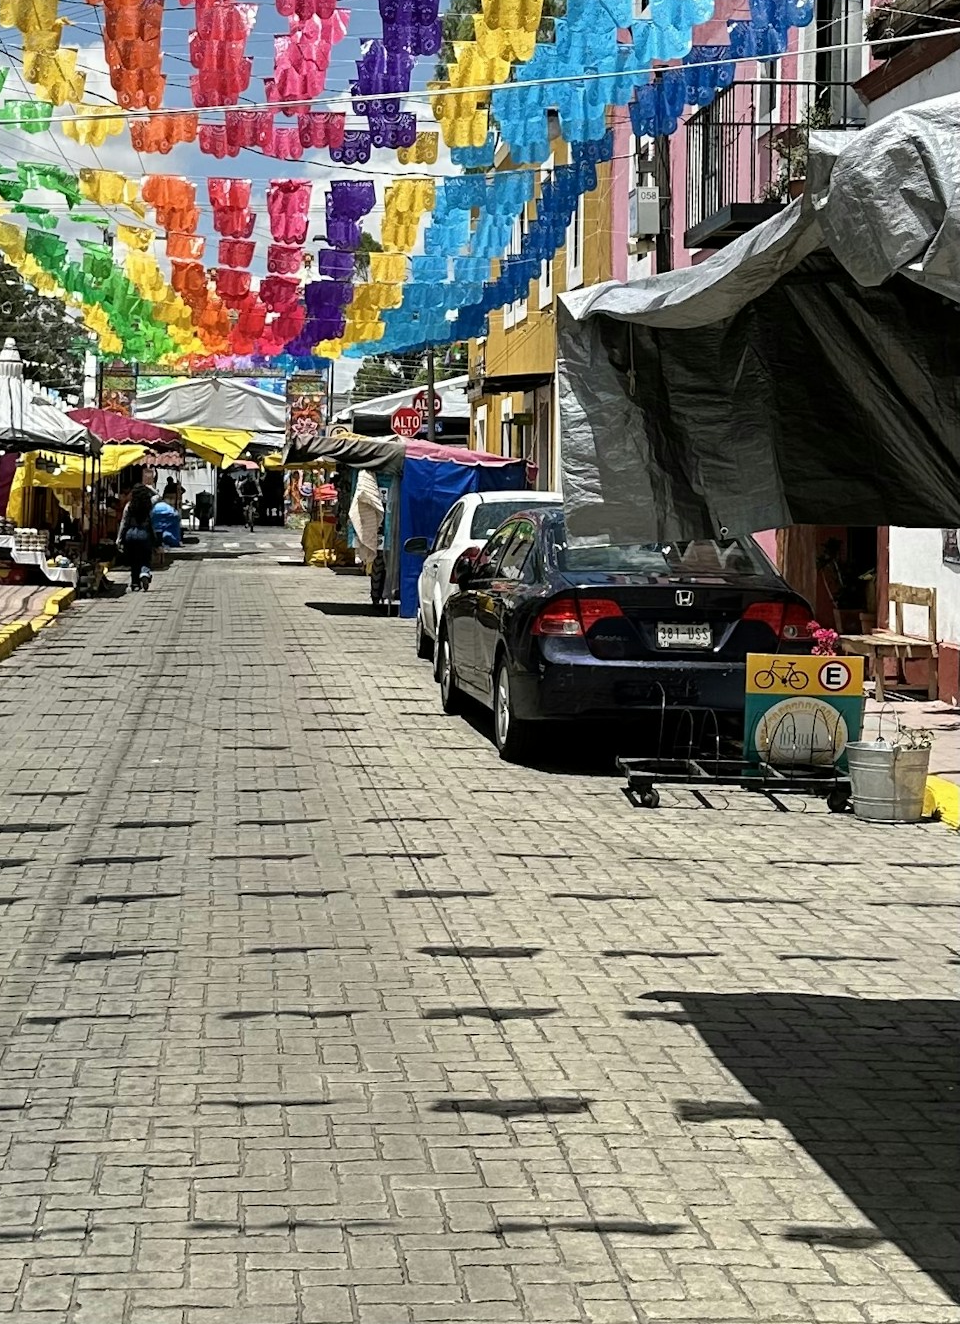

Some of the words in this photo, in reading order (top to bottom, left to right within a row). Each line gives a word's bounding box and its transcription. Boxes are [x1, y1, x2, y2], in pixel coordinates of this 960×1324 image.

[641, 191, 657, 200] 058
[414, 398, 441, 410] ALO
[393, 416, 420, 429] ALTO
[826, 667, 841, 685] E
